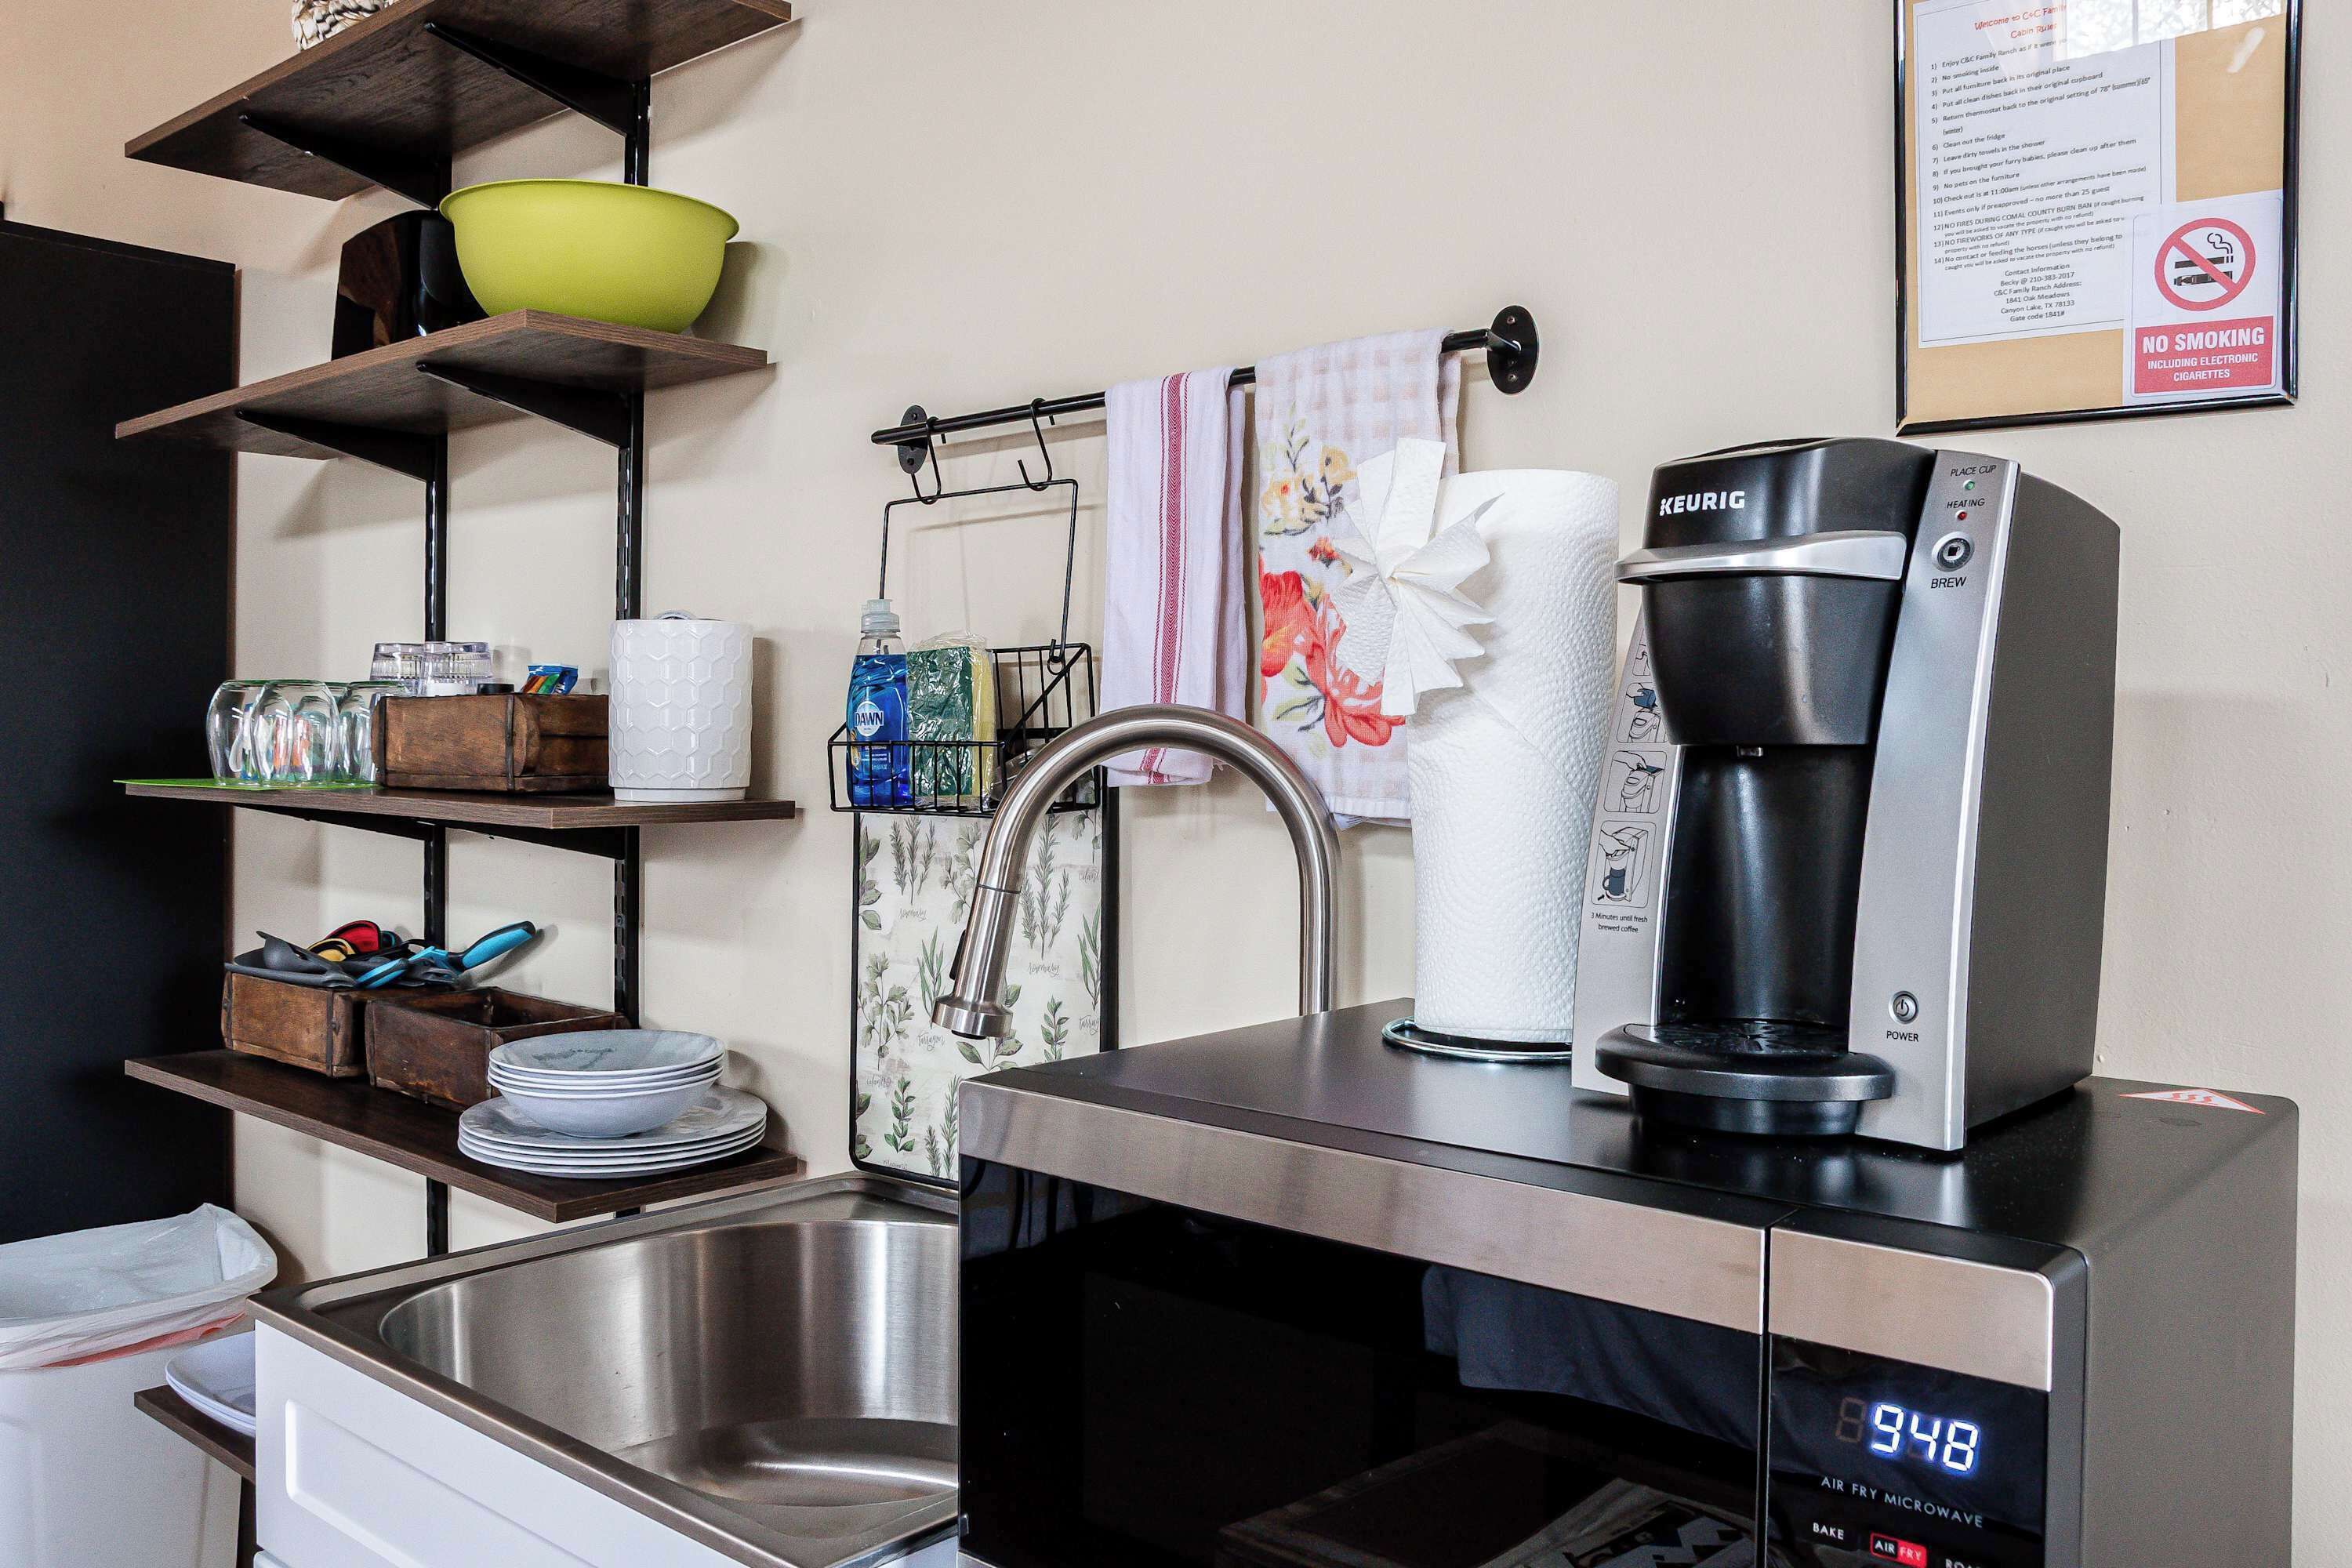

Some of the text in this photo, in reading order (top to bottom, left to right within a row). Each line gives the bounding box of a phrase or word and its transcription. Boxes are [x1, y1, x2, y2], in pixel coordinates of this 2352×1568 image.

[1974, 16, 2009, 29] Welcome
[2010, 27, 2033, 38] Cabin
[1976, 52, 1996, 61] Family
[1952, 69, 1978, 79] smoking
[1963, 81, 1991, 89] furniture
[2026, 68, 2050, 78] original
[2052, 65, 2070, 74] place
[2027, 83, 2042, 92] their
[2044, 78, 2069, 89] original
[2071, 72, 2103, 84] cupboard
[1965, 107, 2001, 117] thermostat
[2039, 94, 2064, 104] original
[2067, 90, 2089, 100] setting
[1962, 163, 1987, 172] brought
[2047, 150, 2068, 158] please
[1991, 172, 2020, 181] furniture
[1987, 198, 2027, 210] preapproved
[2092, 186, 2110, 194] guest
[2027, 208, 2054, 217] COUNTY
[1956, 234, 1993, 244] FIREWORKS
[2031, 263, 2070, 273] Information
[2143, 326, 2265, 354] NO SMOKING
[2147, 353, 2258, 370] INCLUDING ELECTRONIC
[2173, 369, 2230, 382] CIGARETTES
[1950, 465, 1996, 477] PLACE CUP
[1659, 491, 1745, 516] KEURIG
[1947, 498, 1985, 509] HEATING
[1931, 576, 1967, 588] BREW
[855, 712, 884, 726] DAWN
[1886, 1030, 1919, 1042] POWER
[1821, 1476, 1983, 1528] AIR FRY MICROWAVE
[1813, 1522, 1844, 1541] BAKE
[1875, 1540, 1922, 1560] AIR FRY
